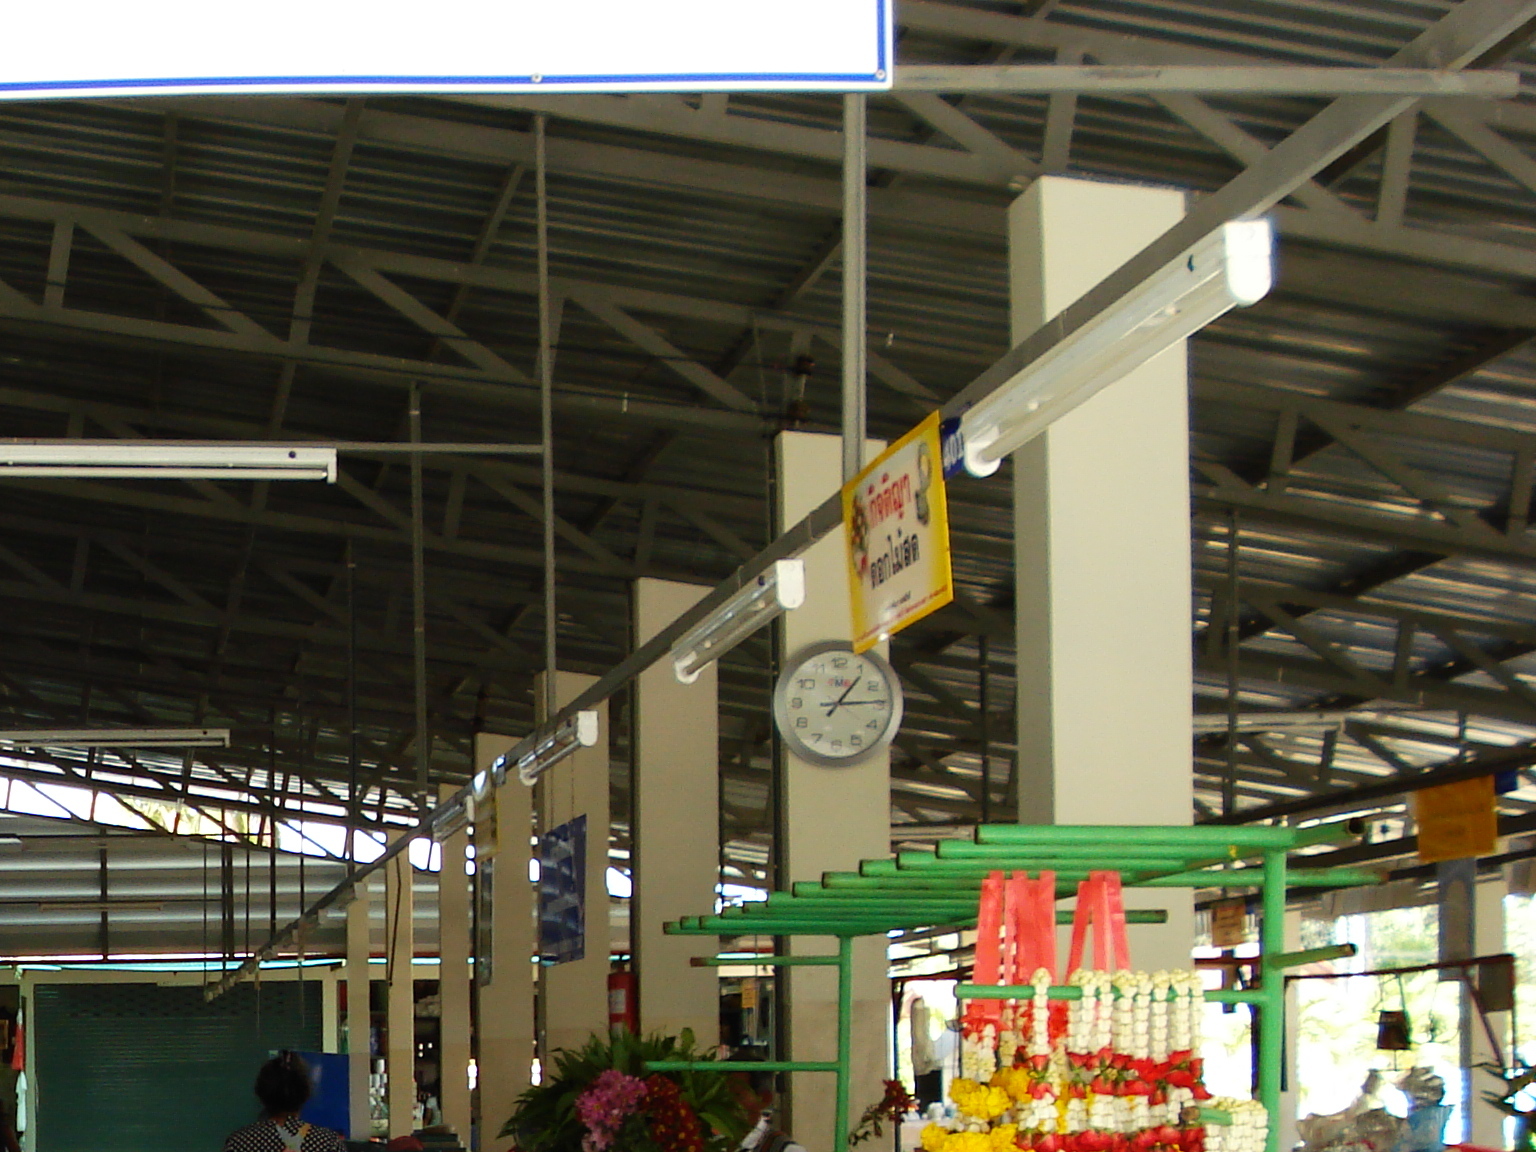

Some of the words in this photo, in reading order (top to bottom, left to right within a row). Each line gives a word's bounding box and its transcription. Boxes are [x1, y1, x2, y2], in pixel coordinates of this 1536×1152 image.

[831, 658, 848, 668] 12
[797, 679, 815, 689] 10
[868, 681, 878, 691] 2
[793, 698, 802, 708] 9
[797, 717, 807, 727] 8
[866, 720, 877, 729] 4
[811, 733, 822, 743] 7
[851, 735, 862, 746] 5
